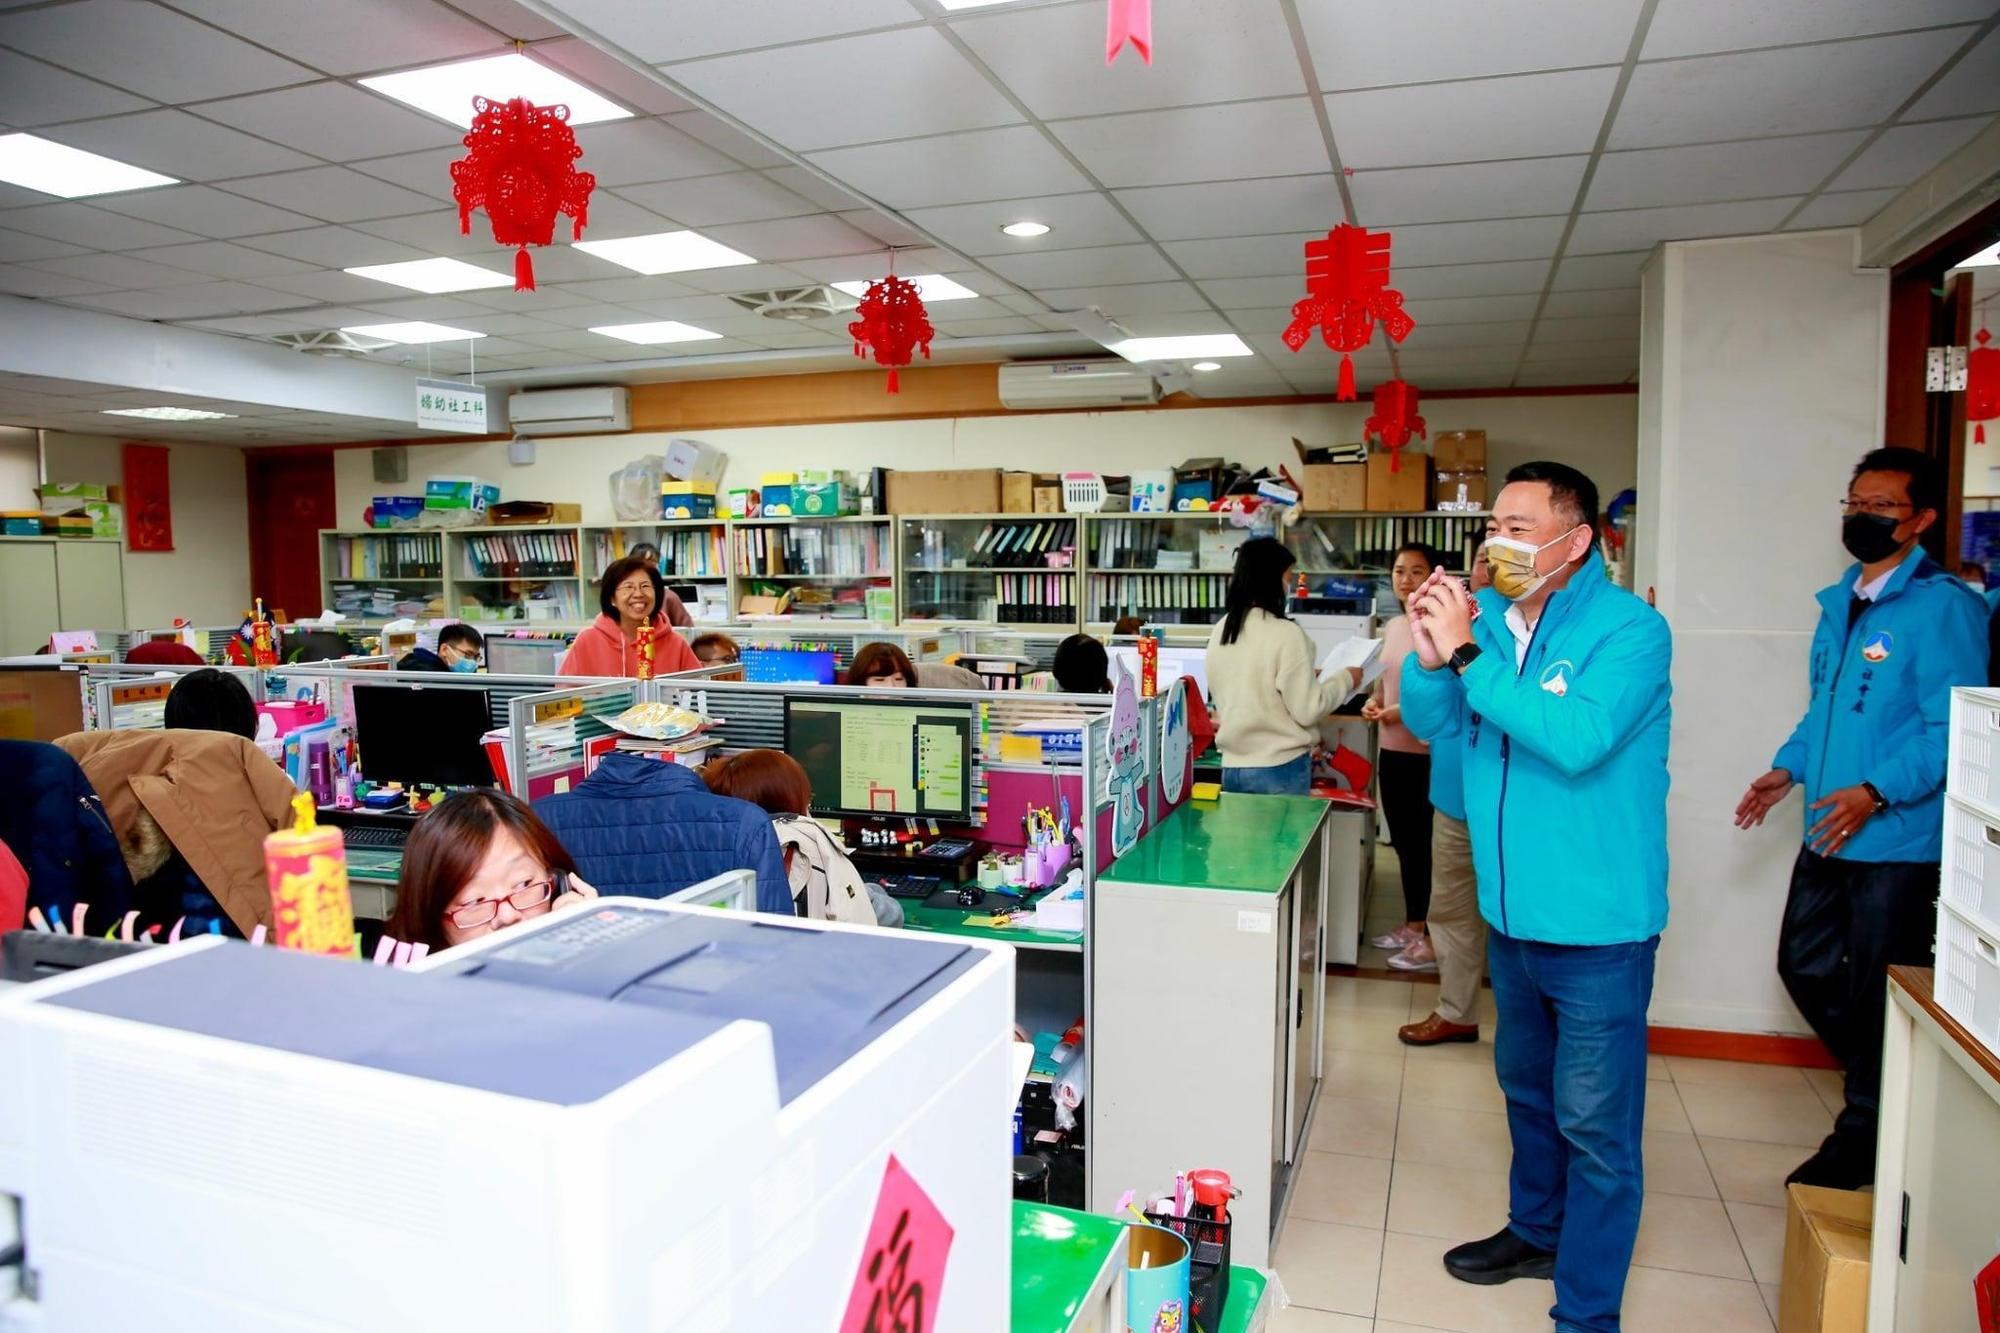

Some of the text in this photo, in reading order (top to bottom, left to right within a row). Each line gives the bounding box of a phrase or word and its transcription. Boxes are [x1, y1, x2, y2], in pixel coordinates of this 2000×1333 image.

[420, 394, 483, 415] 婦幼社工科
